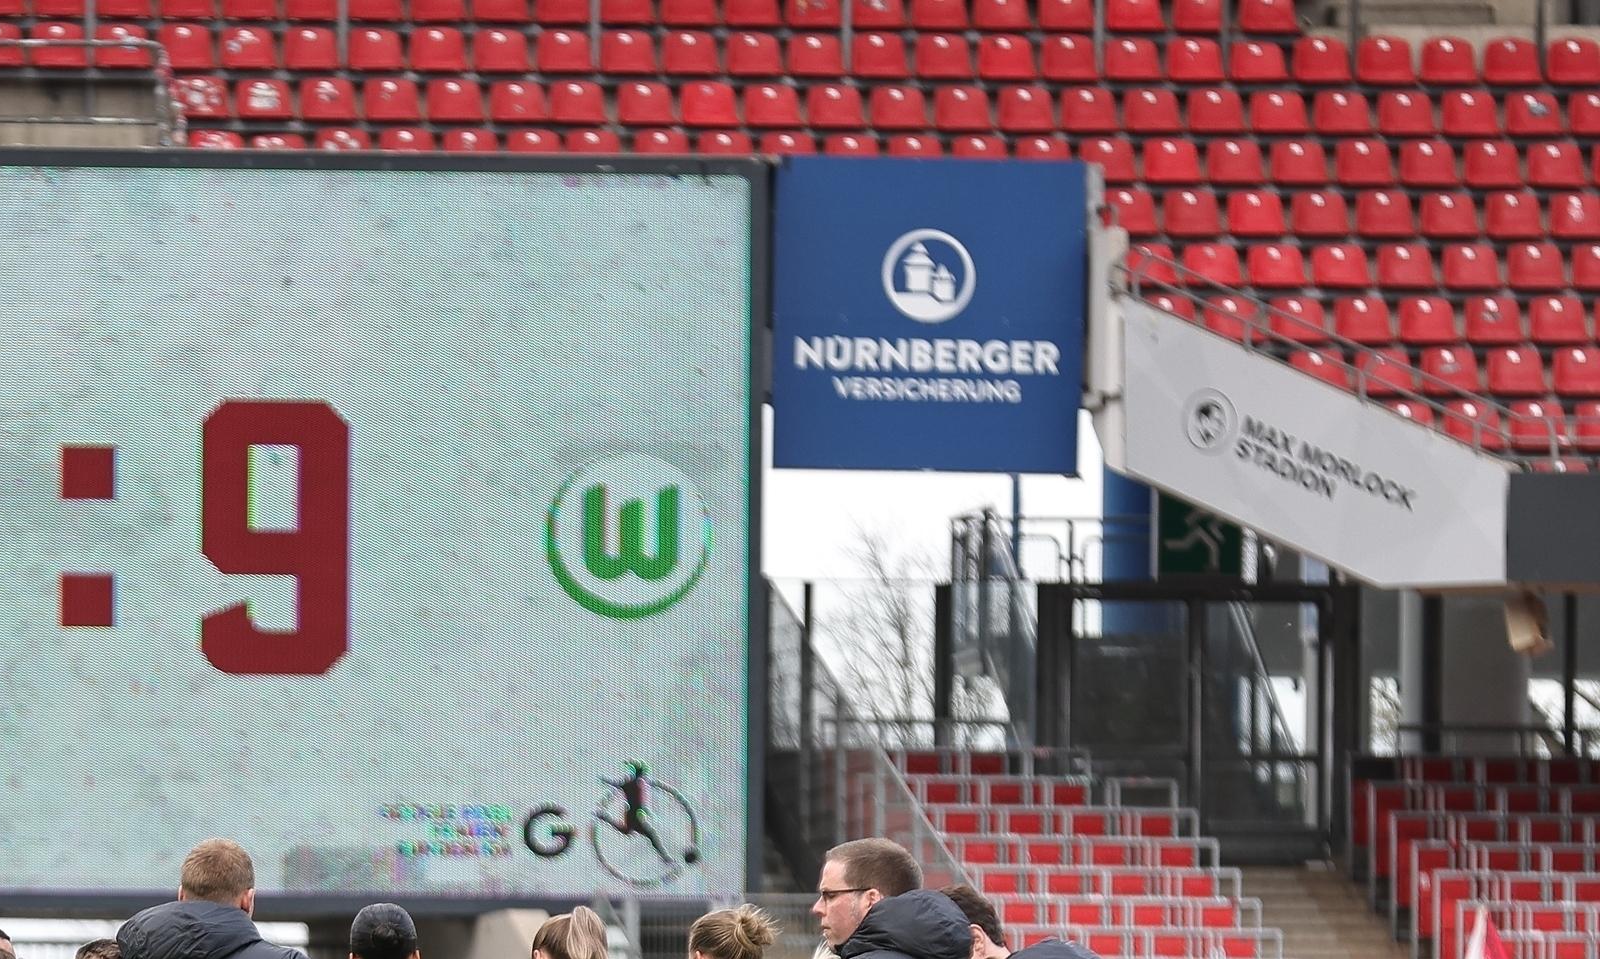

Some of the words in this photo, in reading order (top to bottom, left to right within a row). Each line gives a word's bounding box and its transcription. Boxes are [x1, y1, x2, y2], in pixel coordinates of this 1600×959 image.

[793, 334, 1061, 375] NÜRNBERGER
[831, 376, 1022, 403] VERSICHERUNG
[1235, 437, 1337, 502] STADION
[1243, 414, 1297, 457] MAX
[1299, 440, 1417, 512] MORLOCK
